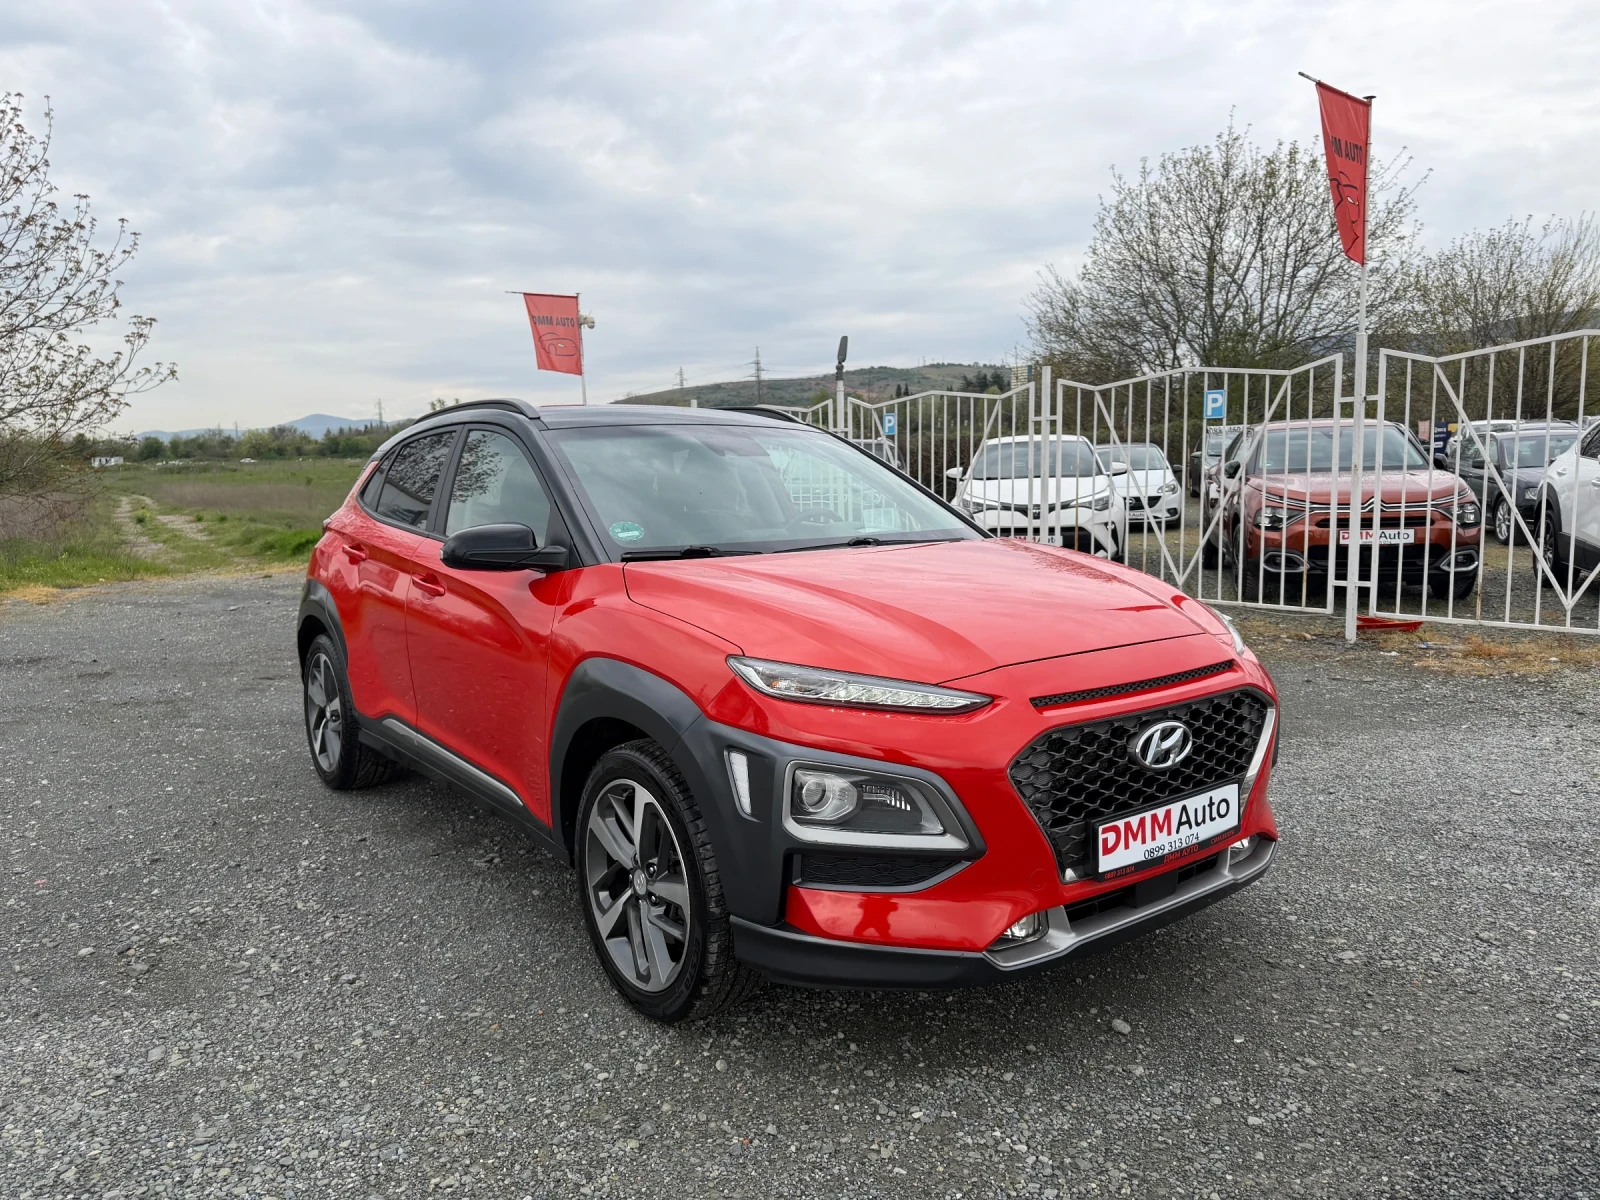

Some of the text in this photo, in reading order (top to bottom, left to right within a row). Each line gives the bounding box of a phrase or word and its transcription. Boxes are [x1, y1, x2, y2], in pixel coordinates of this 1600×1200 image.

[1345, 140, 1362, 166] AUTO
[532, 315, 574, 328] DMM AUTO
[1207, 394, 1223, 416] P
[885, 415, 894, 433] P
[1143, 844, 1166, 860] 0899
[1167, 839, 1183, 852] 313
[1184, 832, 1200, 846] 074
